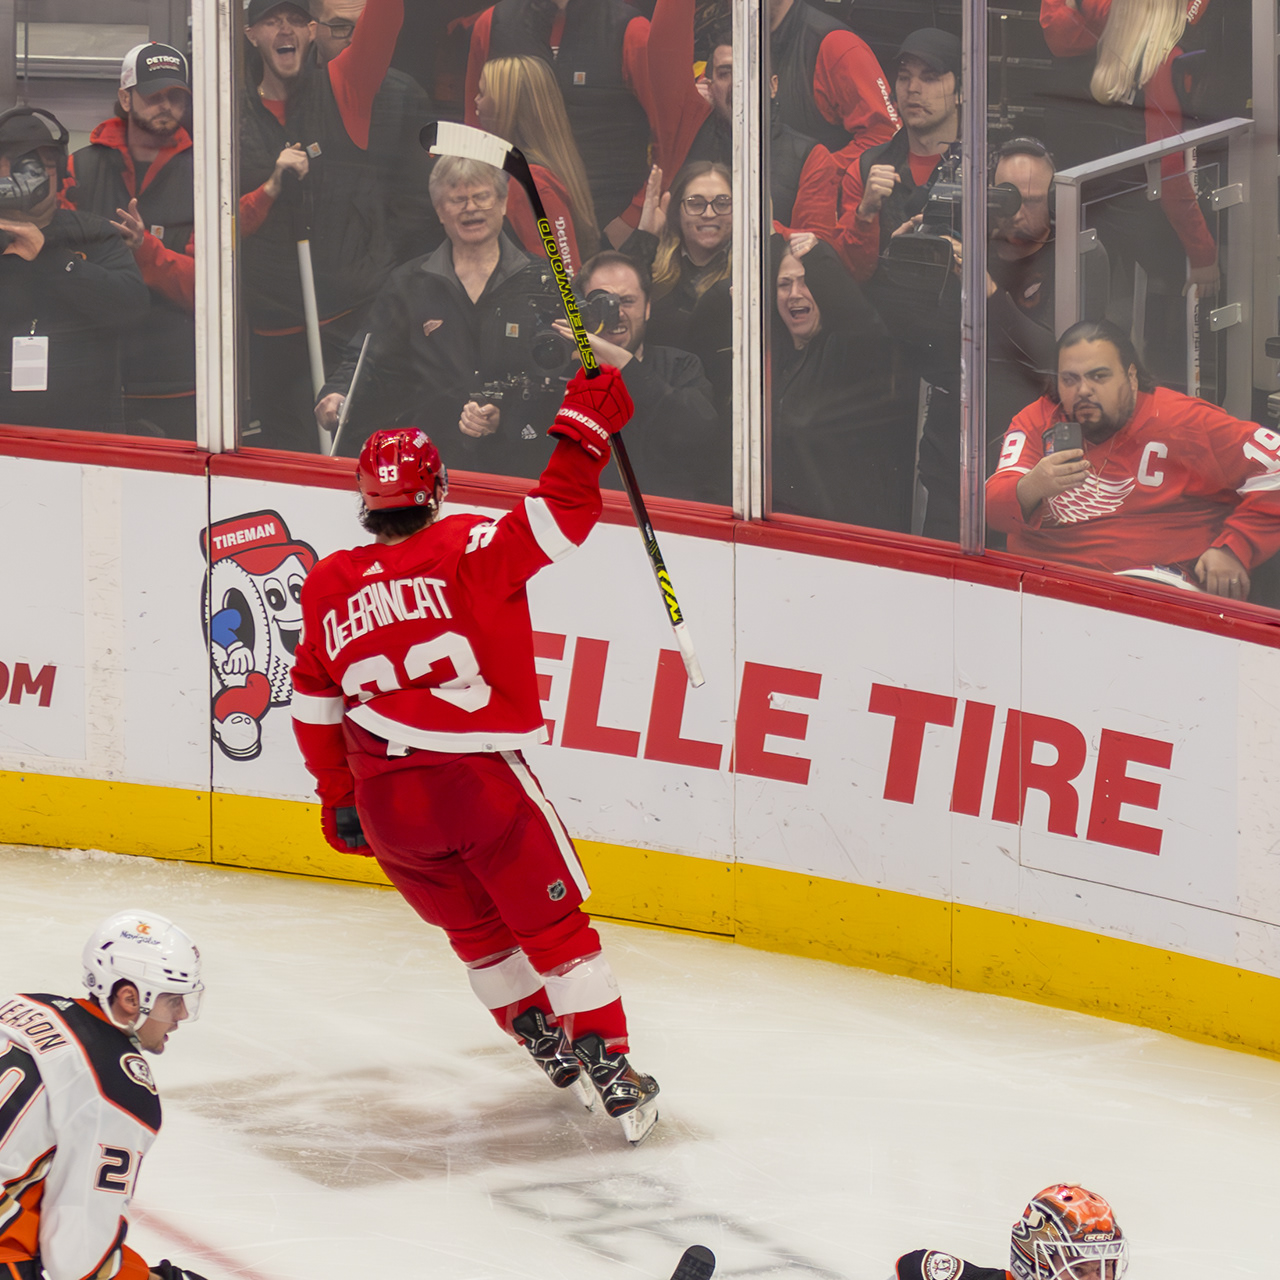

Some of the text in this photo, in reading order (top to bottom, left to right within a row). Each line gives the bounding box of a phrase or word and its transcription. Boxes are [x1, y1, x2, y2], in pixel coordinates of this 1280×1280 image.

[146, 55, 180, 65] DETROIT
[537, 218, 598, 370] SHERWOOD
[558, 408, 610, 441] SHERWO
[379, 465, 398, 483] 93
[1137, 441, 1169, 487] C
[212, 522, 276, 550] TIREMAN
[868, 682, 1174, 856] TIRE
[1084, 1233, 1114, 1242] CCM
